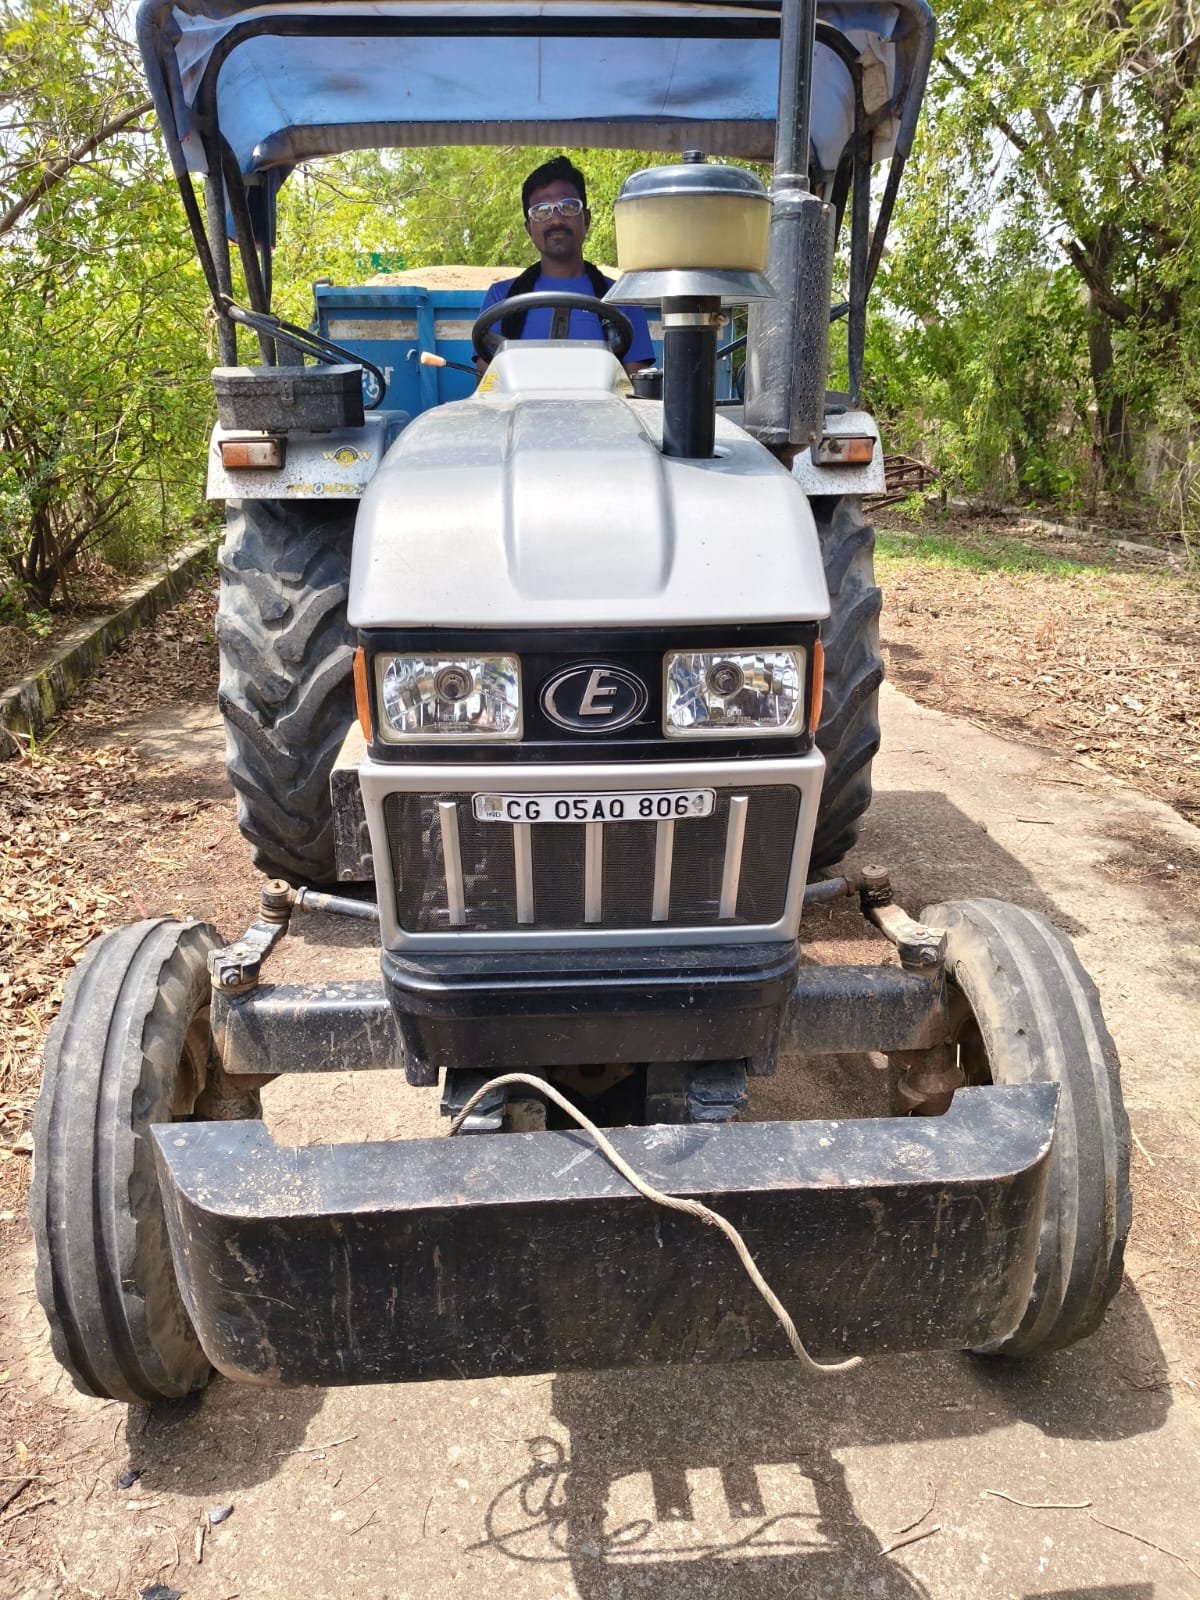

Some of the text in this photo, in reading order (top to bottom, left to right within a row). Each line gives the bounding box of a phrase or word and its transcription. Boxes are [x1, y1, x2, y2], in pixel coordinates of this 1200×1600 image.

[579, 669, 617, 715] E
[506, 800, 541, 820] CG
[554, 798, 625, 820] 05AQ
